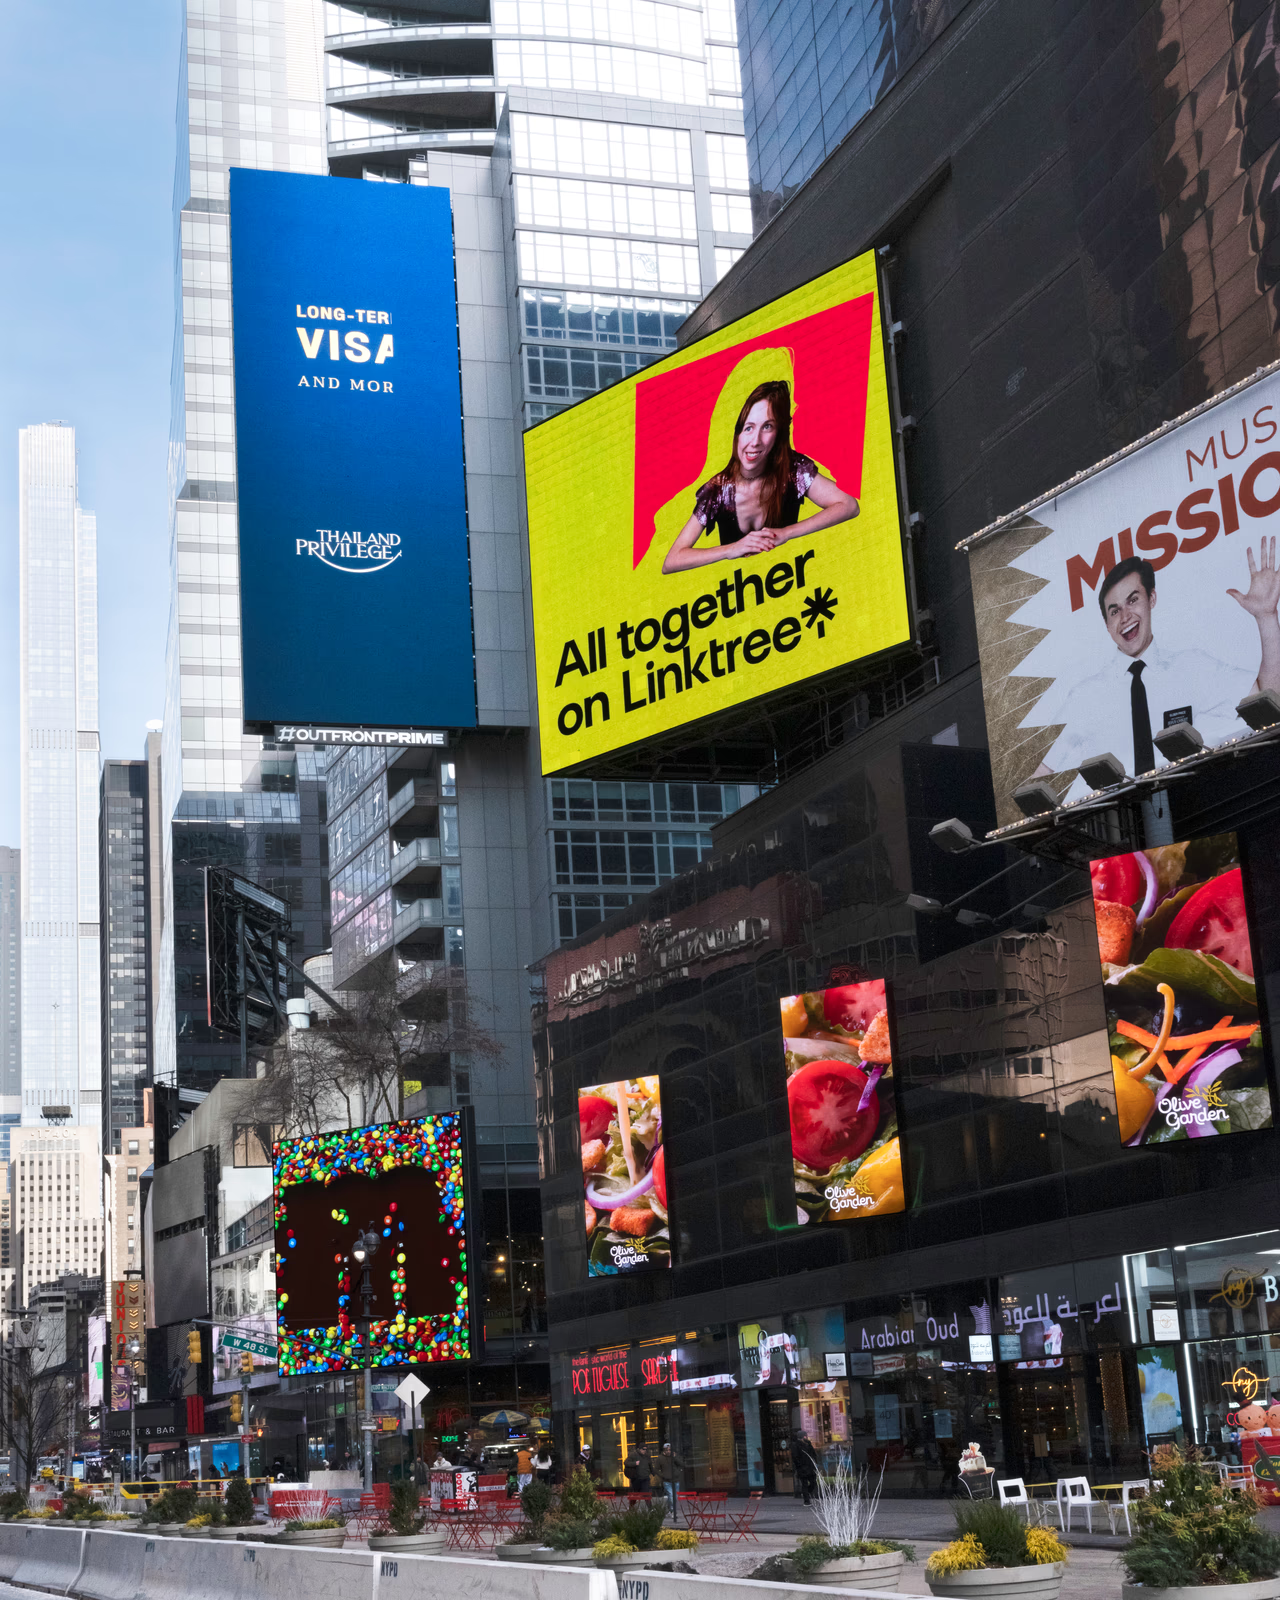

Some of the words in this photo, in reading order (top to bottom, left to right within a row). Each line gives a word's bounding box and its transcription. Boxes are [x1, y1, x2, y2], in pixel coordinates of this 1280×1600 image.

[296, 304, 392, 325] LONG-TER
[296, 327, 394, 364] VISA
[298, 375, 340, 389] AND
[350, 378, 394, 393] MOR
[1186, 405, 1278, 482] MUS
[316, 529, 401, 546] THAILAND
[1066, 451, 1280, 612] MISSIO
[295, 538, 397, 561] PRIVILEGE
[554, 627, 608, 688] All
[617, 549, 815, 655] together
[557, 691, 610, 736] on
[278, 726, 445, 745] #OUTFRONTPRIME
[1157, 1096, 1202, 1114] Olive
[1165, 1107, 1230, 1130] Garden
[824, 1186, 856, 1200] Olive
[830, 1195, 875, 1213] Garden
[610, 1245, 634, 1257] Olive
[614, 1253, 649, 1268] Garden
[116, 1282, 127, 1366] JUNIO
[926, 1312, 960, 1341] Oud
[233, 1339, 241, 1347] W
[243, 1342, 256, 1351] 48
[258, 1345, 268, 1354] St
[572, 1362, 629, 1395] PORTUGUESE
[157, 1426, 175, 1434] BAR
[381, 1561, 399, 1577] NYPD
[621, 1580, 650, 1600] NYPD
